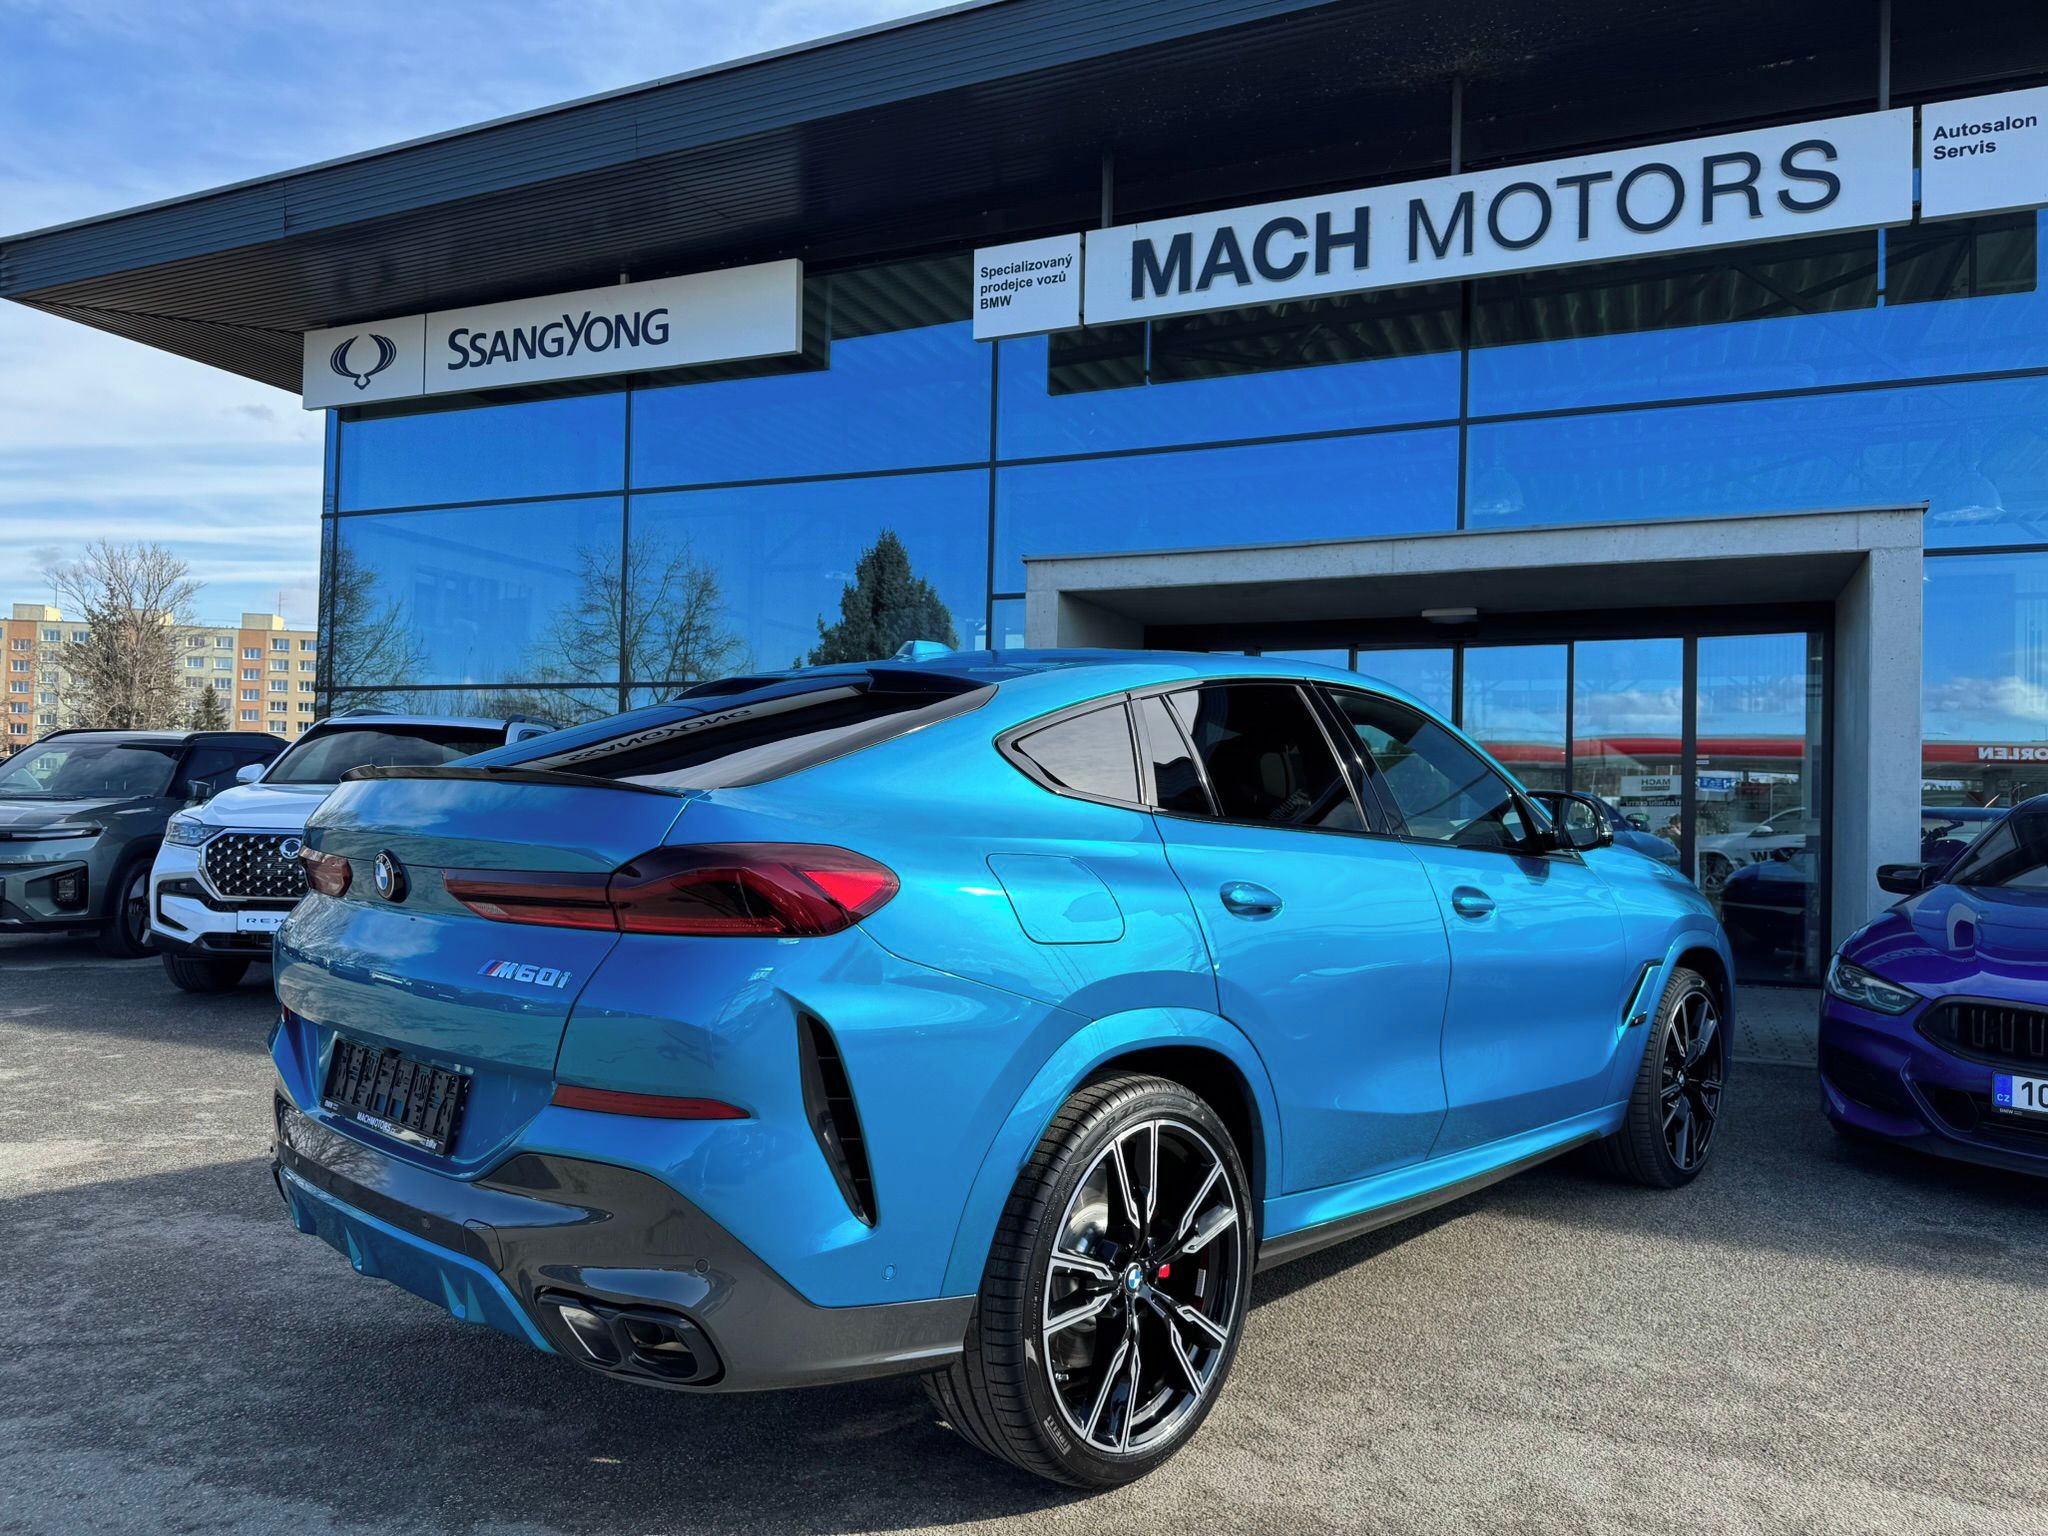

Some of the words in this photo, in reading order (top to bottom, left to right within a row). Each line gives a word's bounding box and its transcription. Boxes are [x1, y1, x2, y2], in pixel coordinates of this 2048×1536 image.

[1933, 116, 2037, 141] Autosalon
[1933, 140, 1996, 160] Servis
[1131, 205, 1370, 300] MACH
[1408, 139, 1842, 263] MOTORS
[980, 254, 1072, 279] Specializovaný
[980, 278, 1033, 296] prodejce
[980, 295, 1012, 309] BMW
[447, 308, 669, 371] SSANGYONG
[488, 961, 572, 989] M60i
[1996, 1093, 2010, 1102] CZ
